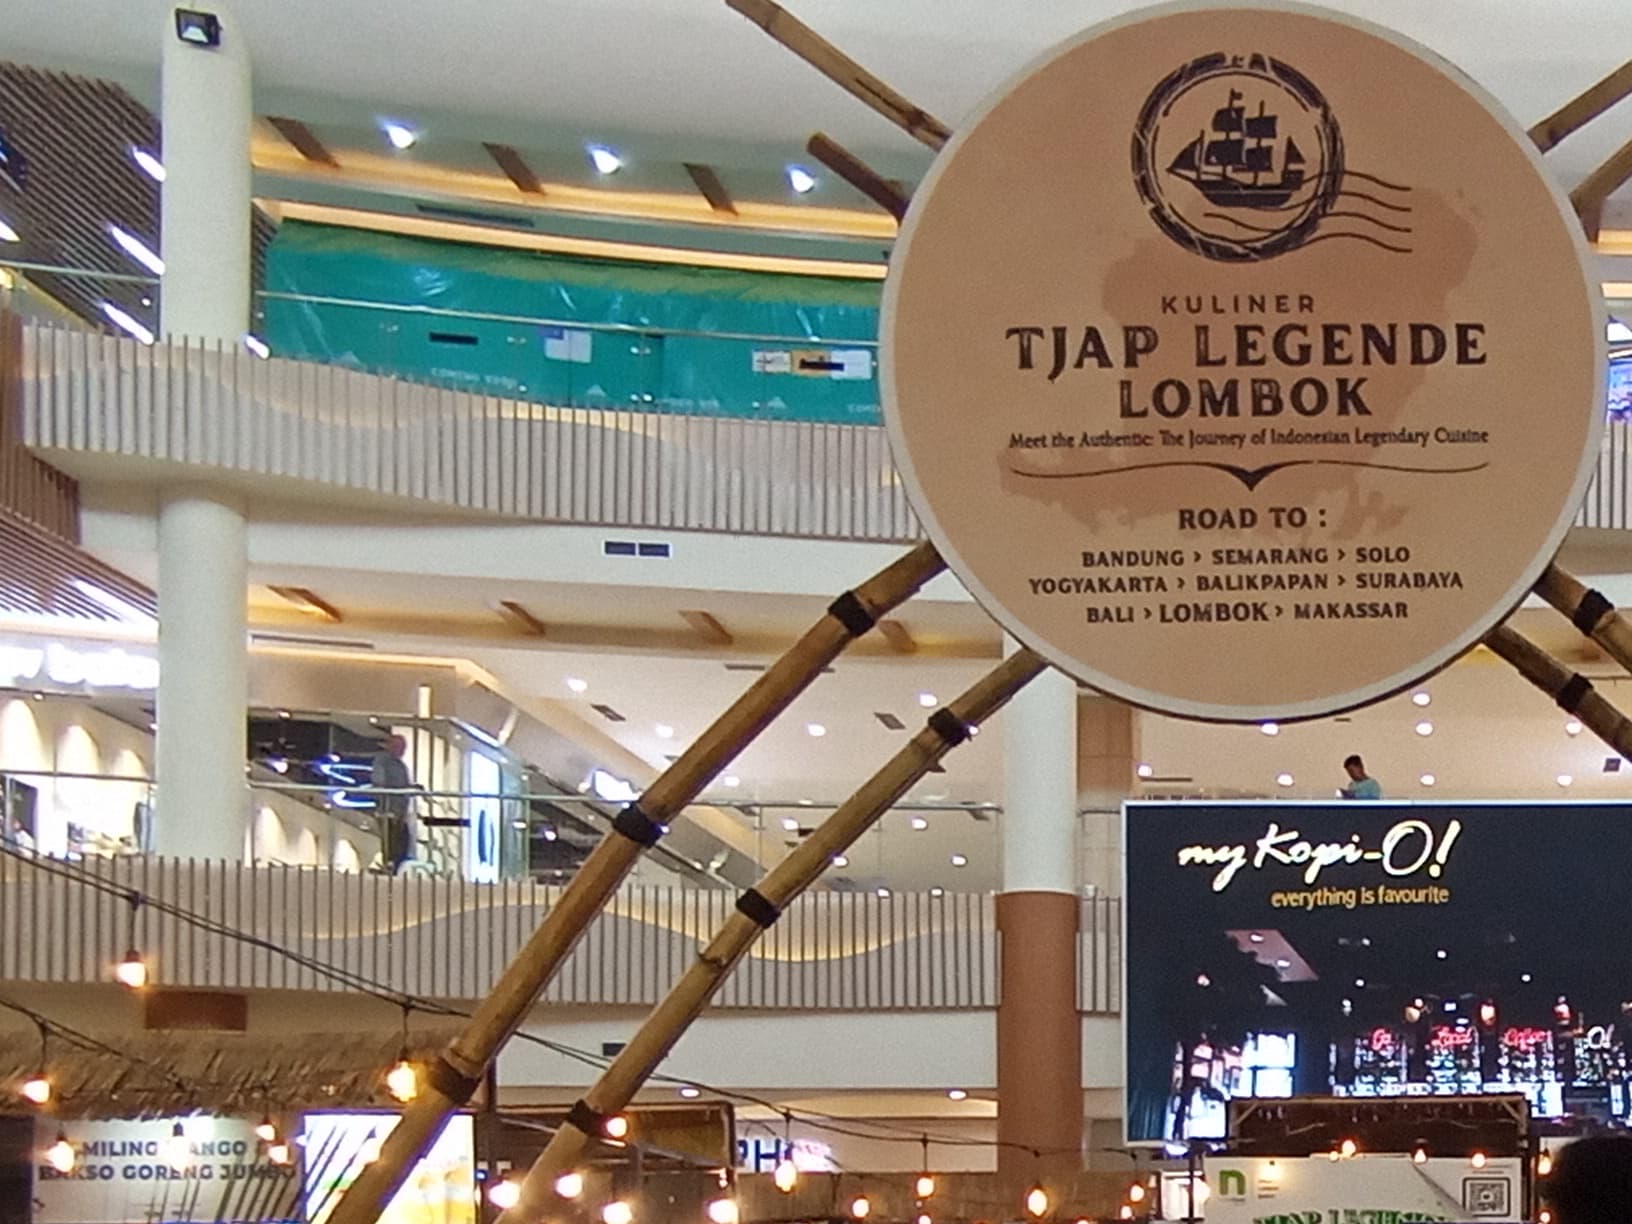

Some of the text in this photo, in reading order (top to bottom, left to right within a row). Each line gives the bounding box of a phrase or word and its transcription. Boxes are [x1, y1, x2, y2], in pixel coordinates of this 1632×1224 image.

[1161, 295, 1316, 314] KULINER
[1005, 322, 1487, 383] TJAP LEGENDE
[1119, 376, 1373, 419] LOMBOK
[1009, 432, 1047, 449] Meet
[1050, 431, 1075, 448] the
[1158, 428, 1185, 446] The
[1188, 429, 1246, 451] Journey
[1250, 428, 1267, 446] of
[1270, 427, 1351, 446] Indonesian
[1354, 427, 1429, 448] Legendary
[1436, 427, 1489, 445] Cuisine
[1177, 507, 1258, 530] ROAD
[1268, 507, 1307, 529] TO
[1081, 546, 1411, 568] BANDUNG SEMARANG SOLO
[1028, 571, 1464, 595] YOGYAKARTA BALIKPAPAN SURABAYA
[1086, 602, 1409, 625] BALI LOMBOK MAKASSAR
[1177, 819, 1462, 892] my Kopi-O!
[1271, 884, 1450, 911] everything is favourite
[76, 1140, 247, 1157] MILING ANGO
[122, 1164, 213, 1181] GORENG
